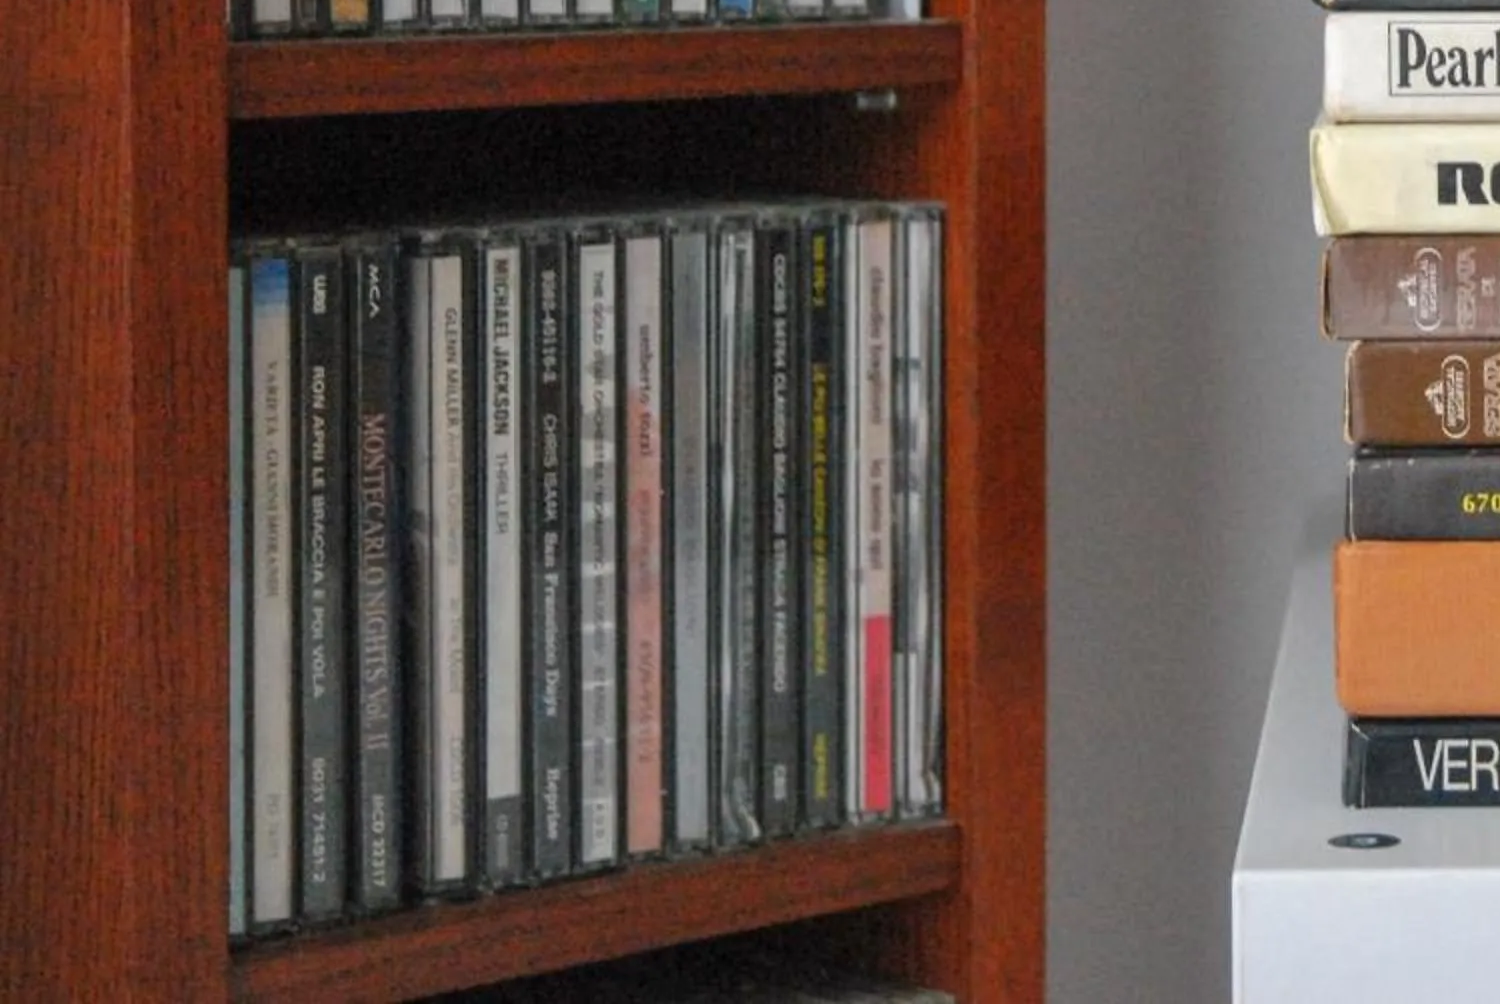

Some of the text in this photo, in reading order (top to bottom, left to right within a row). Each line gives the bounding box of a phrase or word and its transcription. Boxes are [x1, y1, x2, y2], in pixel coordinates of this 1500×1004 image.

[493, 257, 510, 534] MICHAEL JACKSON THRILLER
[364, 589, 387, 683] NIGHTS
